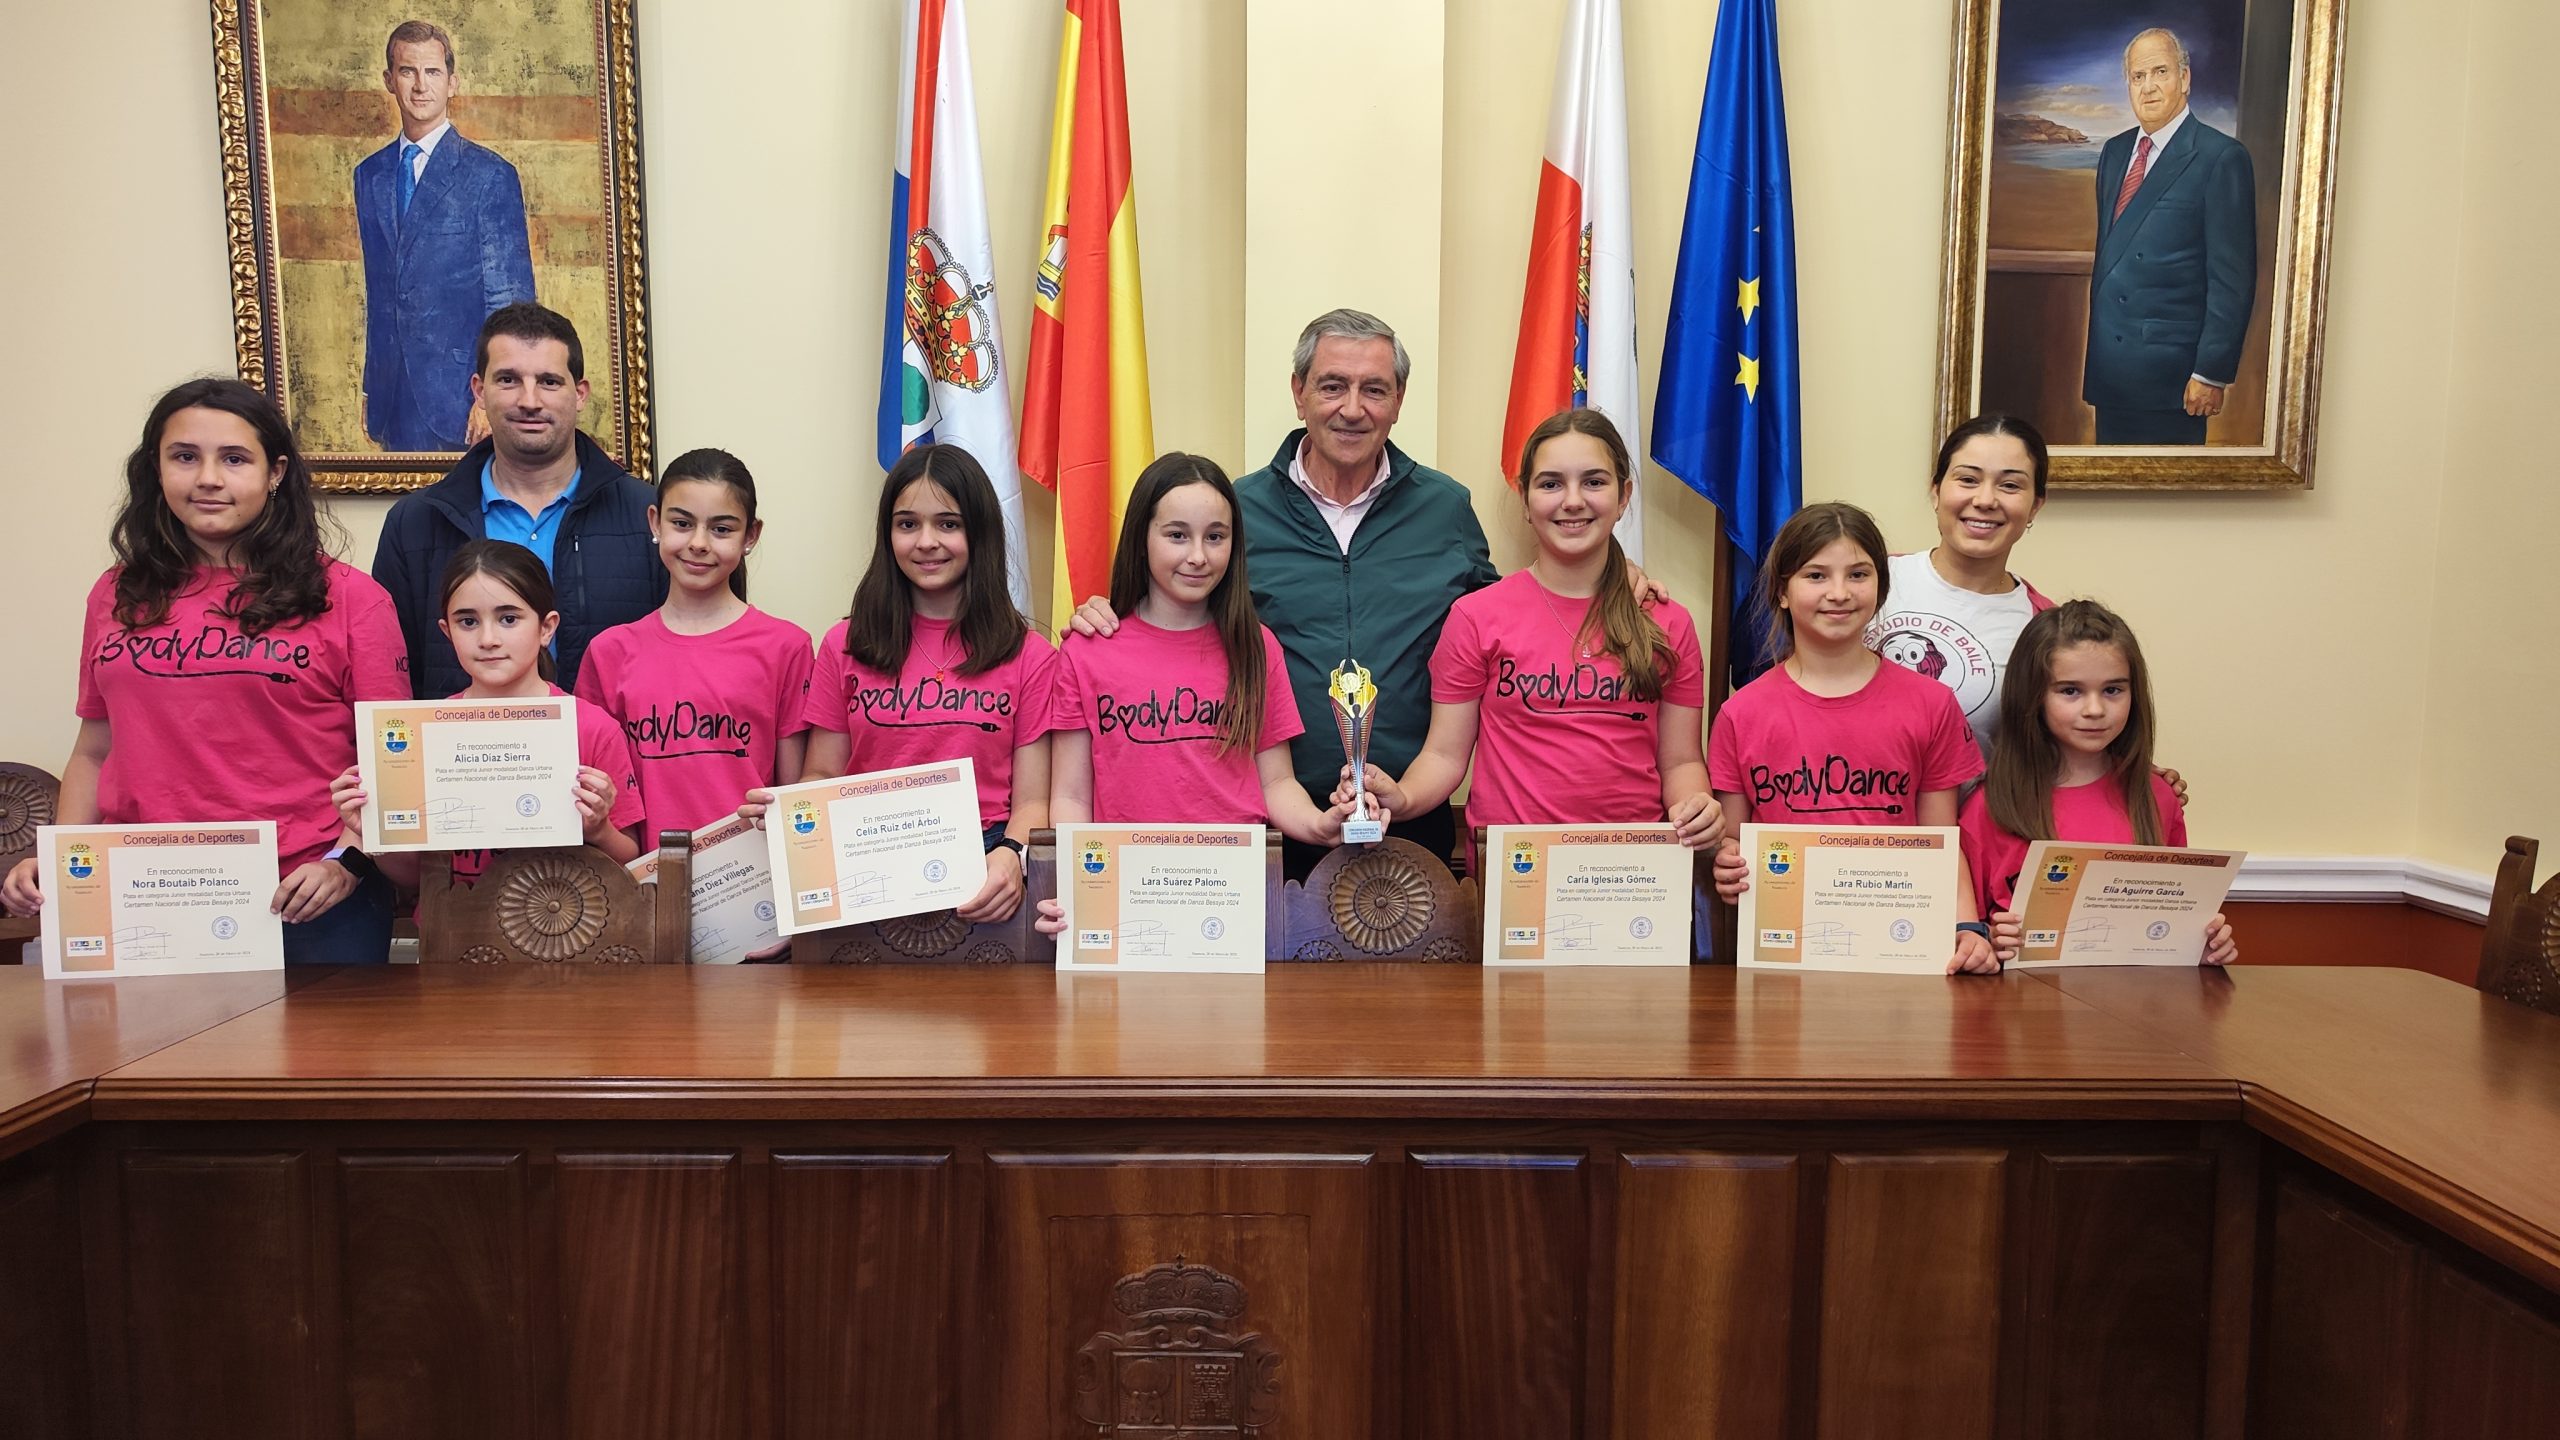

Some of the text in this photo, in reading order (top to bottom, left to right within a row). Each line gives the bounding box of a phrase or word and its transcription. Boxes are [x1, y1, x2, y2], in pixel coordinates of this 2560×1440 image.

[1929, 620, 1955, 637] DE
[1954, 636, 1986, 677] BAILE
[488, 708, 500, 718] de
[503, 707, 547, 720] Deportes
[468, 741, 520, 750] reconocimiento
[454, 752, 530, 762] Alicia Díaz Sierra
[890, 779, 903, 789] de
[905, 772, 947, 787] Deportes
[863, 815, 872, 823] En
[874, 807, 924, 822] reconocimiento
[855, 816, 940, 836] Celia Ruiz del Árbol
[181, 833, 194, 843] de
[197, 832, 245, 845] Deportes
[702, 825, 742, 847] Deportes
[1182, 833, 1194, 843] de
[1196, 834, 1238, 846] Deportes
[1611, 833, 1623, 842] de
[1625, 832, 1666, 844] Deportes
[1872, 836, 1884, 845] de
[1887, 836, 1931, 849] Deportes
[159, 866, 216, 875] reconocimiento
[722, 864, 755, 881] Villegas
[1161, 866, 1211, 874] reconocimiento
[1578, 864, 1587, 872] En
[1849, 868, 1902, 876] reconocimiento
[132, 877, 239, 888] Nora Boutaib Polanco
[1141, 877, 1227, 886] Lara Suárez Palomo
[1591, 875, 1623, 885] Iglesias
[1626, 875, 1656, 883] Gómez
[1833, 879, 1912, 889] Lara Rubio Martín
[2120, 887, 2154, 896] Aguirre
